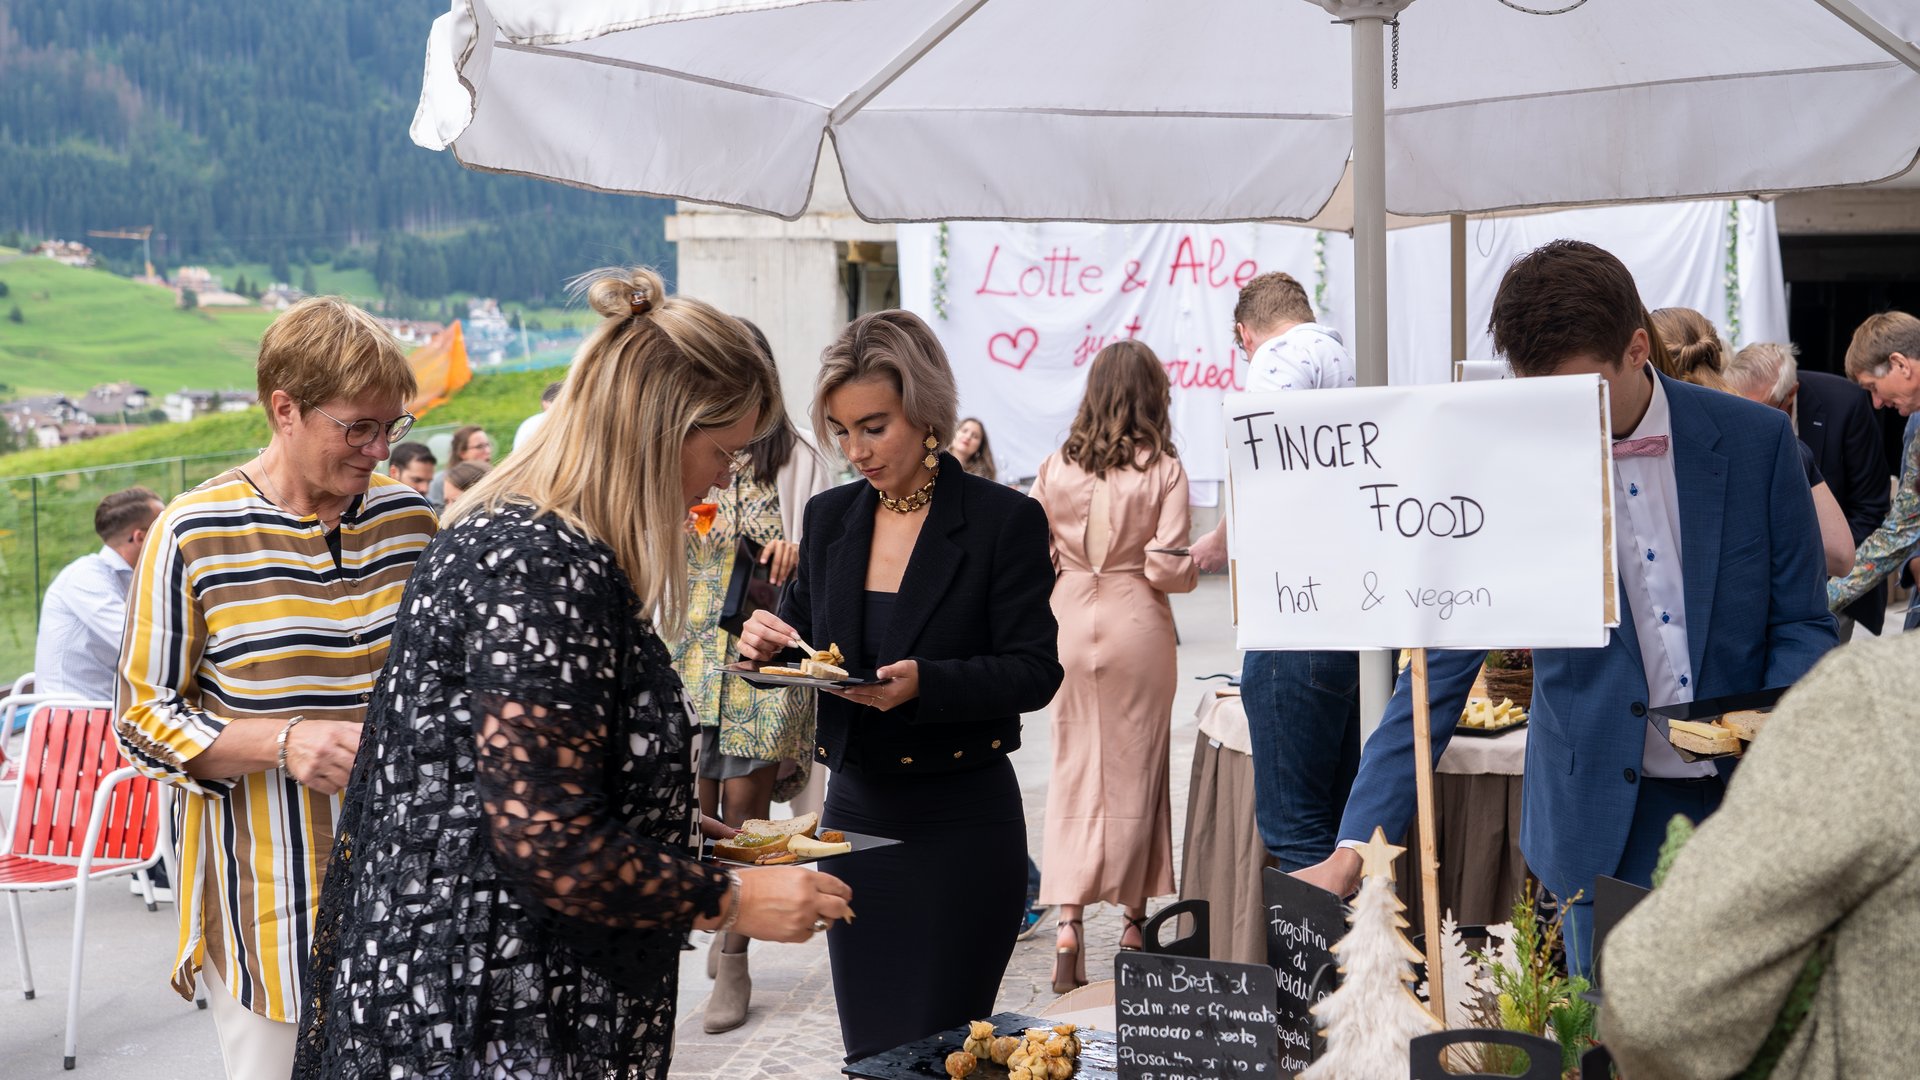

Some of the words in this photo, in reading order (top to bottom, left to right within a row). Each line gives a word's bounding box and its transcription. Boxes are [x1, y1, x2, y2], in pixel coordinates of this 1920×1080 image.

[975, 245, 1103, 297] Lotte
[1121, 259, 1147, 293] &
[1169, 235, 1258, 288] Ale
[1073, 315, 1142, 367] jut
[1161, 349, 1245, 392] rried
[1233, 411, 1382, 471] FINGER
[1359, 483, 1485, 538] FOOD
[1275, 571, 1322, 614] hot
[1361, 570, 1385, 612] &
[1405, 585, 1492, 620] vegan
[1292, 950, 1308, 972] di
[1120, 998, 1191, 1016] Salmne
